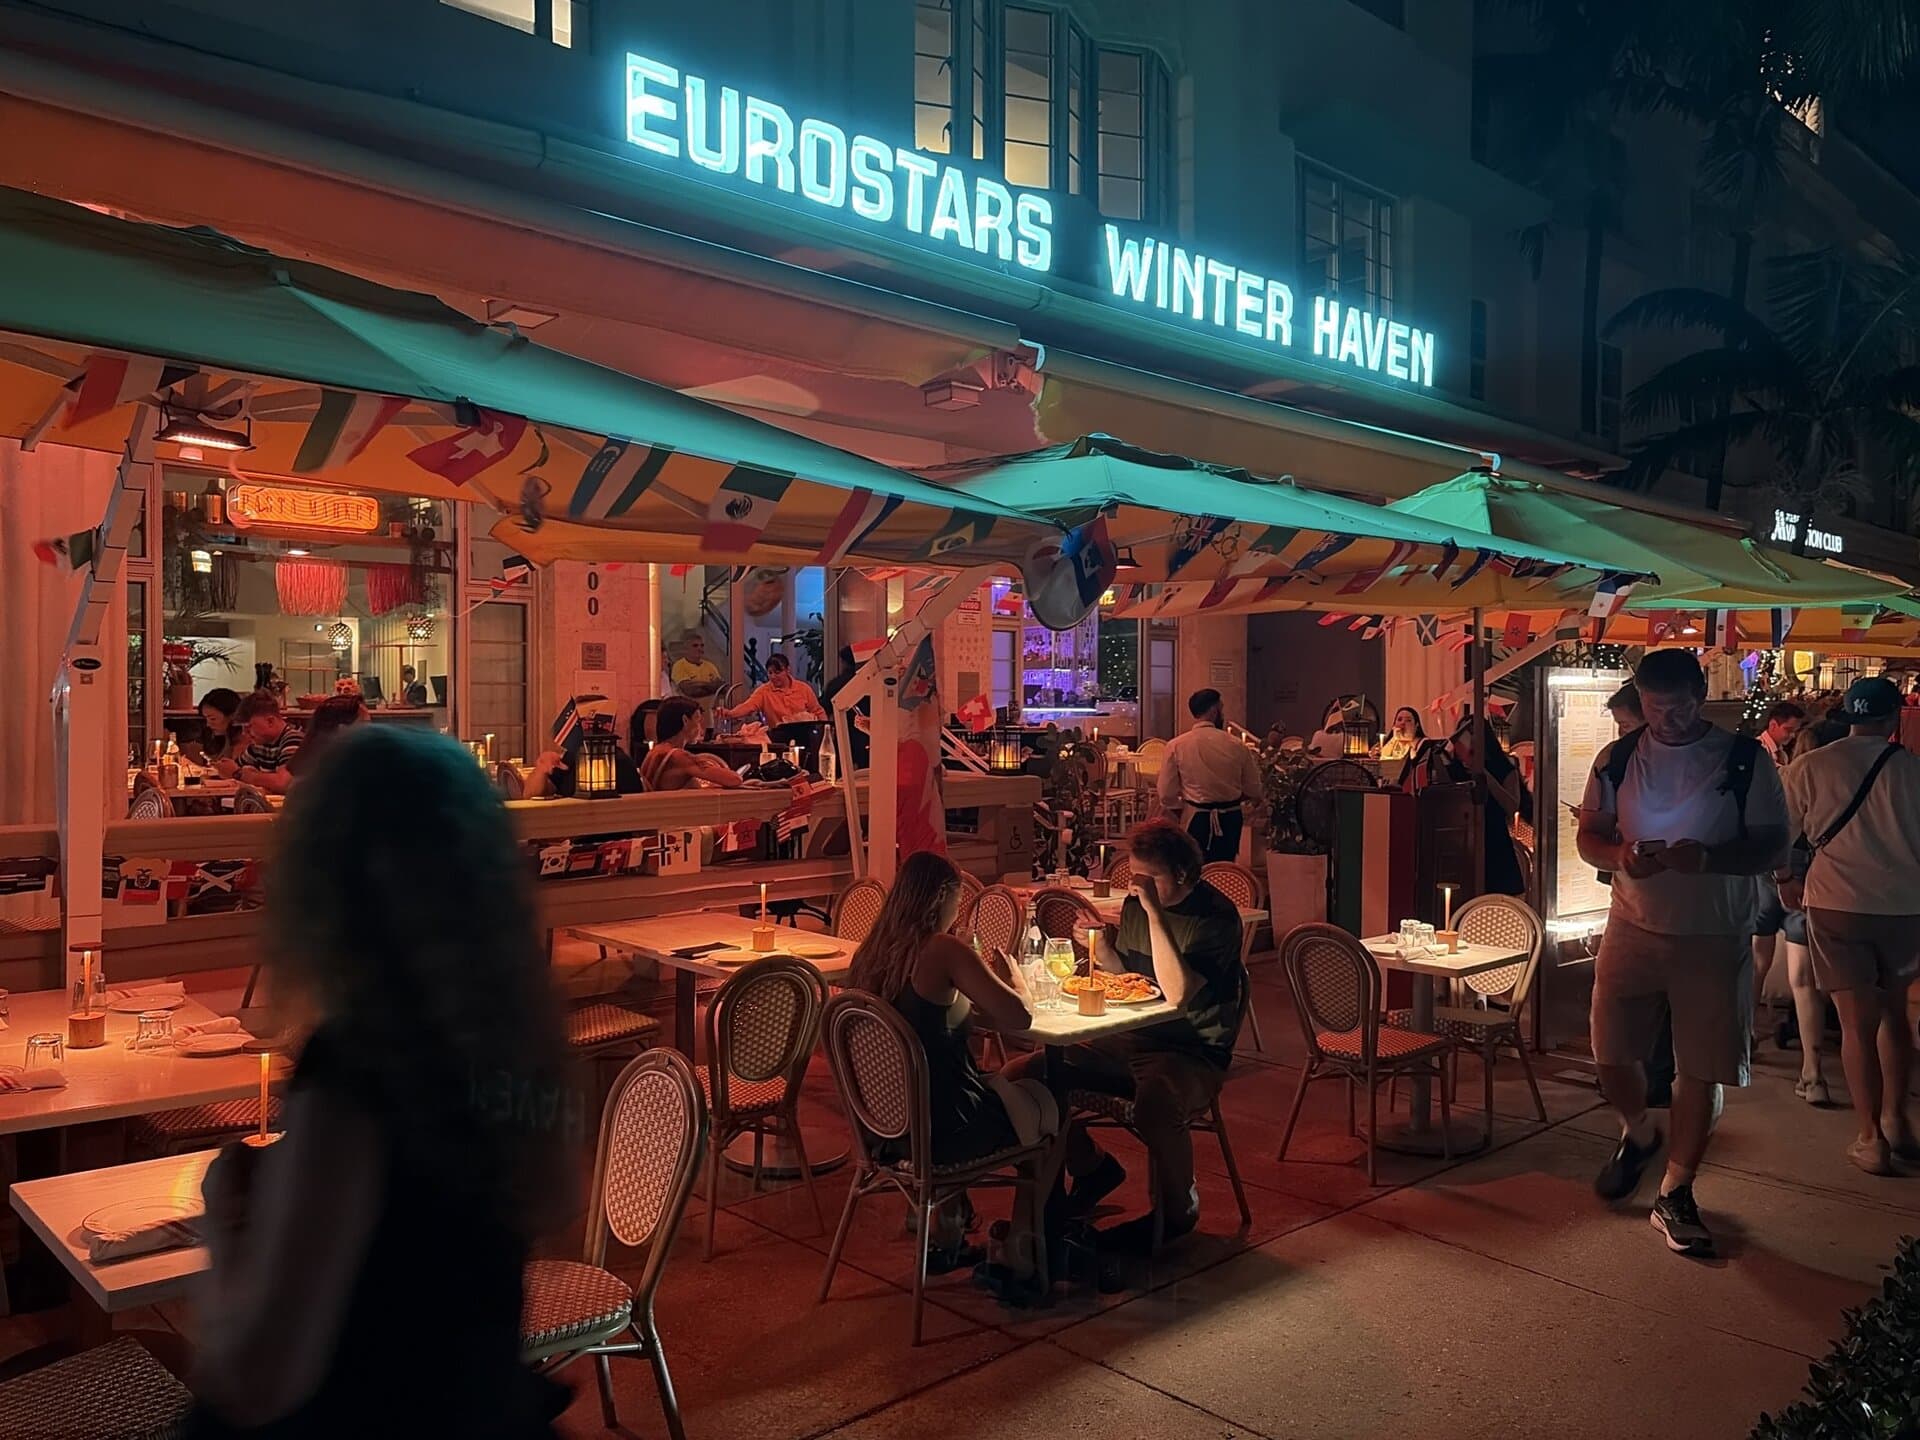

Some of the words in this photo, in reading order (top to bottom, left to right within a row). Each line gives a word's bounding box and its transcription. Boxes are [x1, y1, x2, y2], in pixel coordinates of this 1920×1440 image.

[626, 51, 1053, 272] EUROSTARS
[1105, 223, 1294, 346] WINTER
[1313, 295, 1434, 387] HAVEN
[1823, 532, 1842, 553] CLUB
